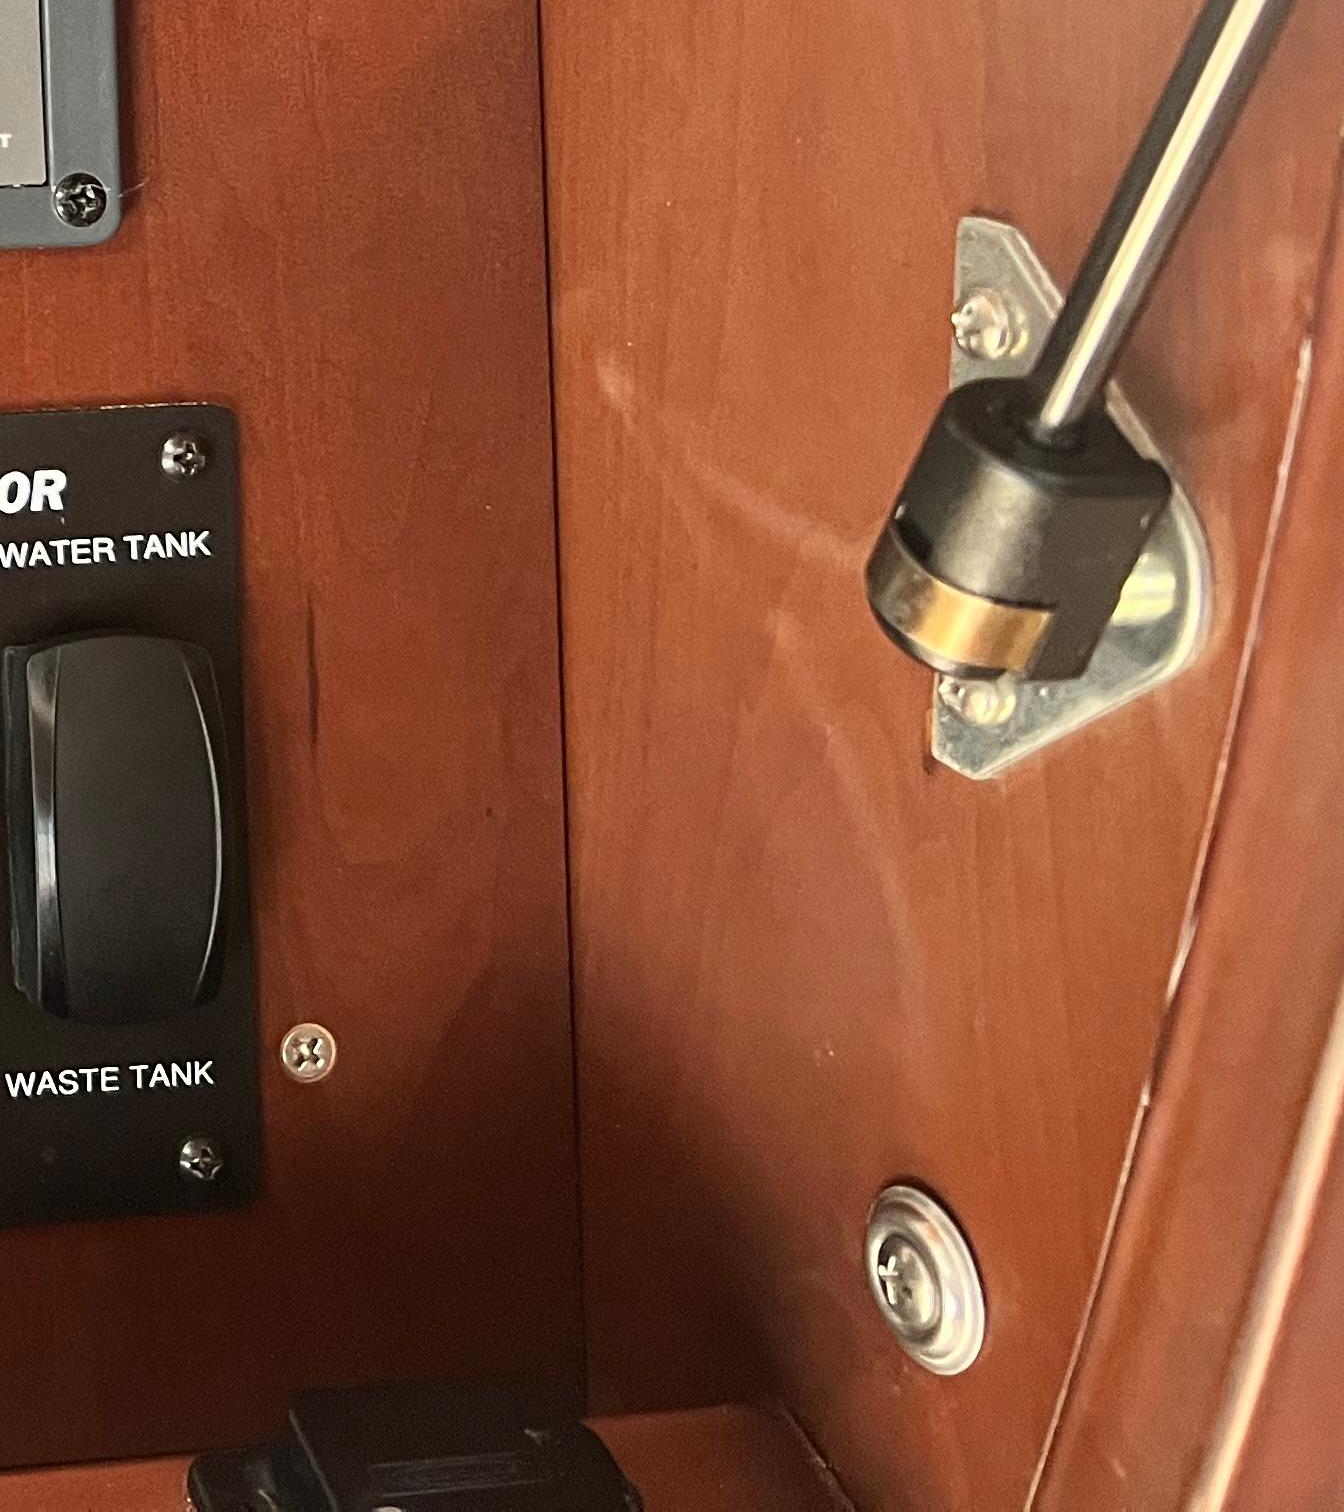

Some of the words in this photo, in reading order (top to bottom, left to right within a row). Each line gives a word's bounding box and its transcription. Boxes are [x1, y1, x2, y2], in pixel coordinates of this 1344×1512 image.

[123, 531, 211, 560] TANK
[5, 1066, 119, 1097] WASTE
[129, 1061, 213, 1088] TANK
